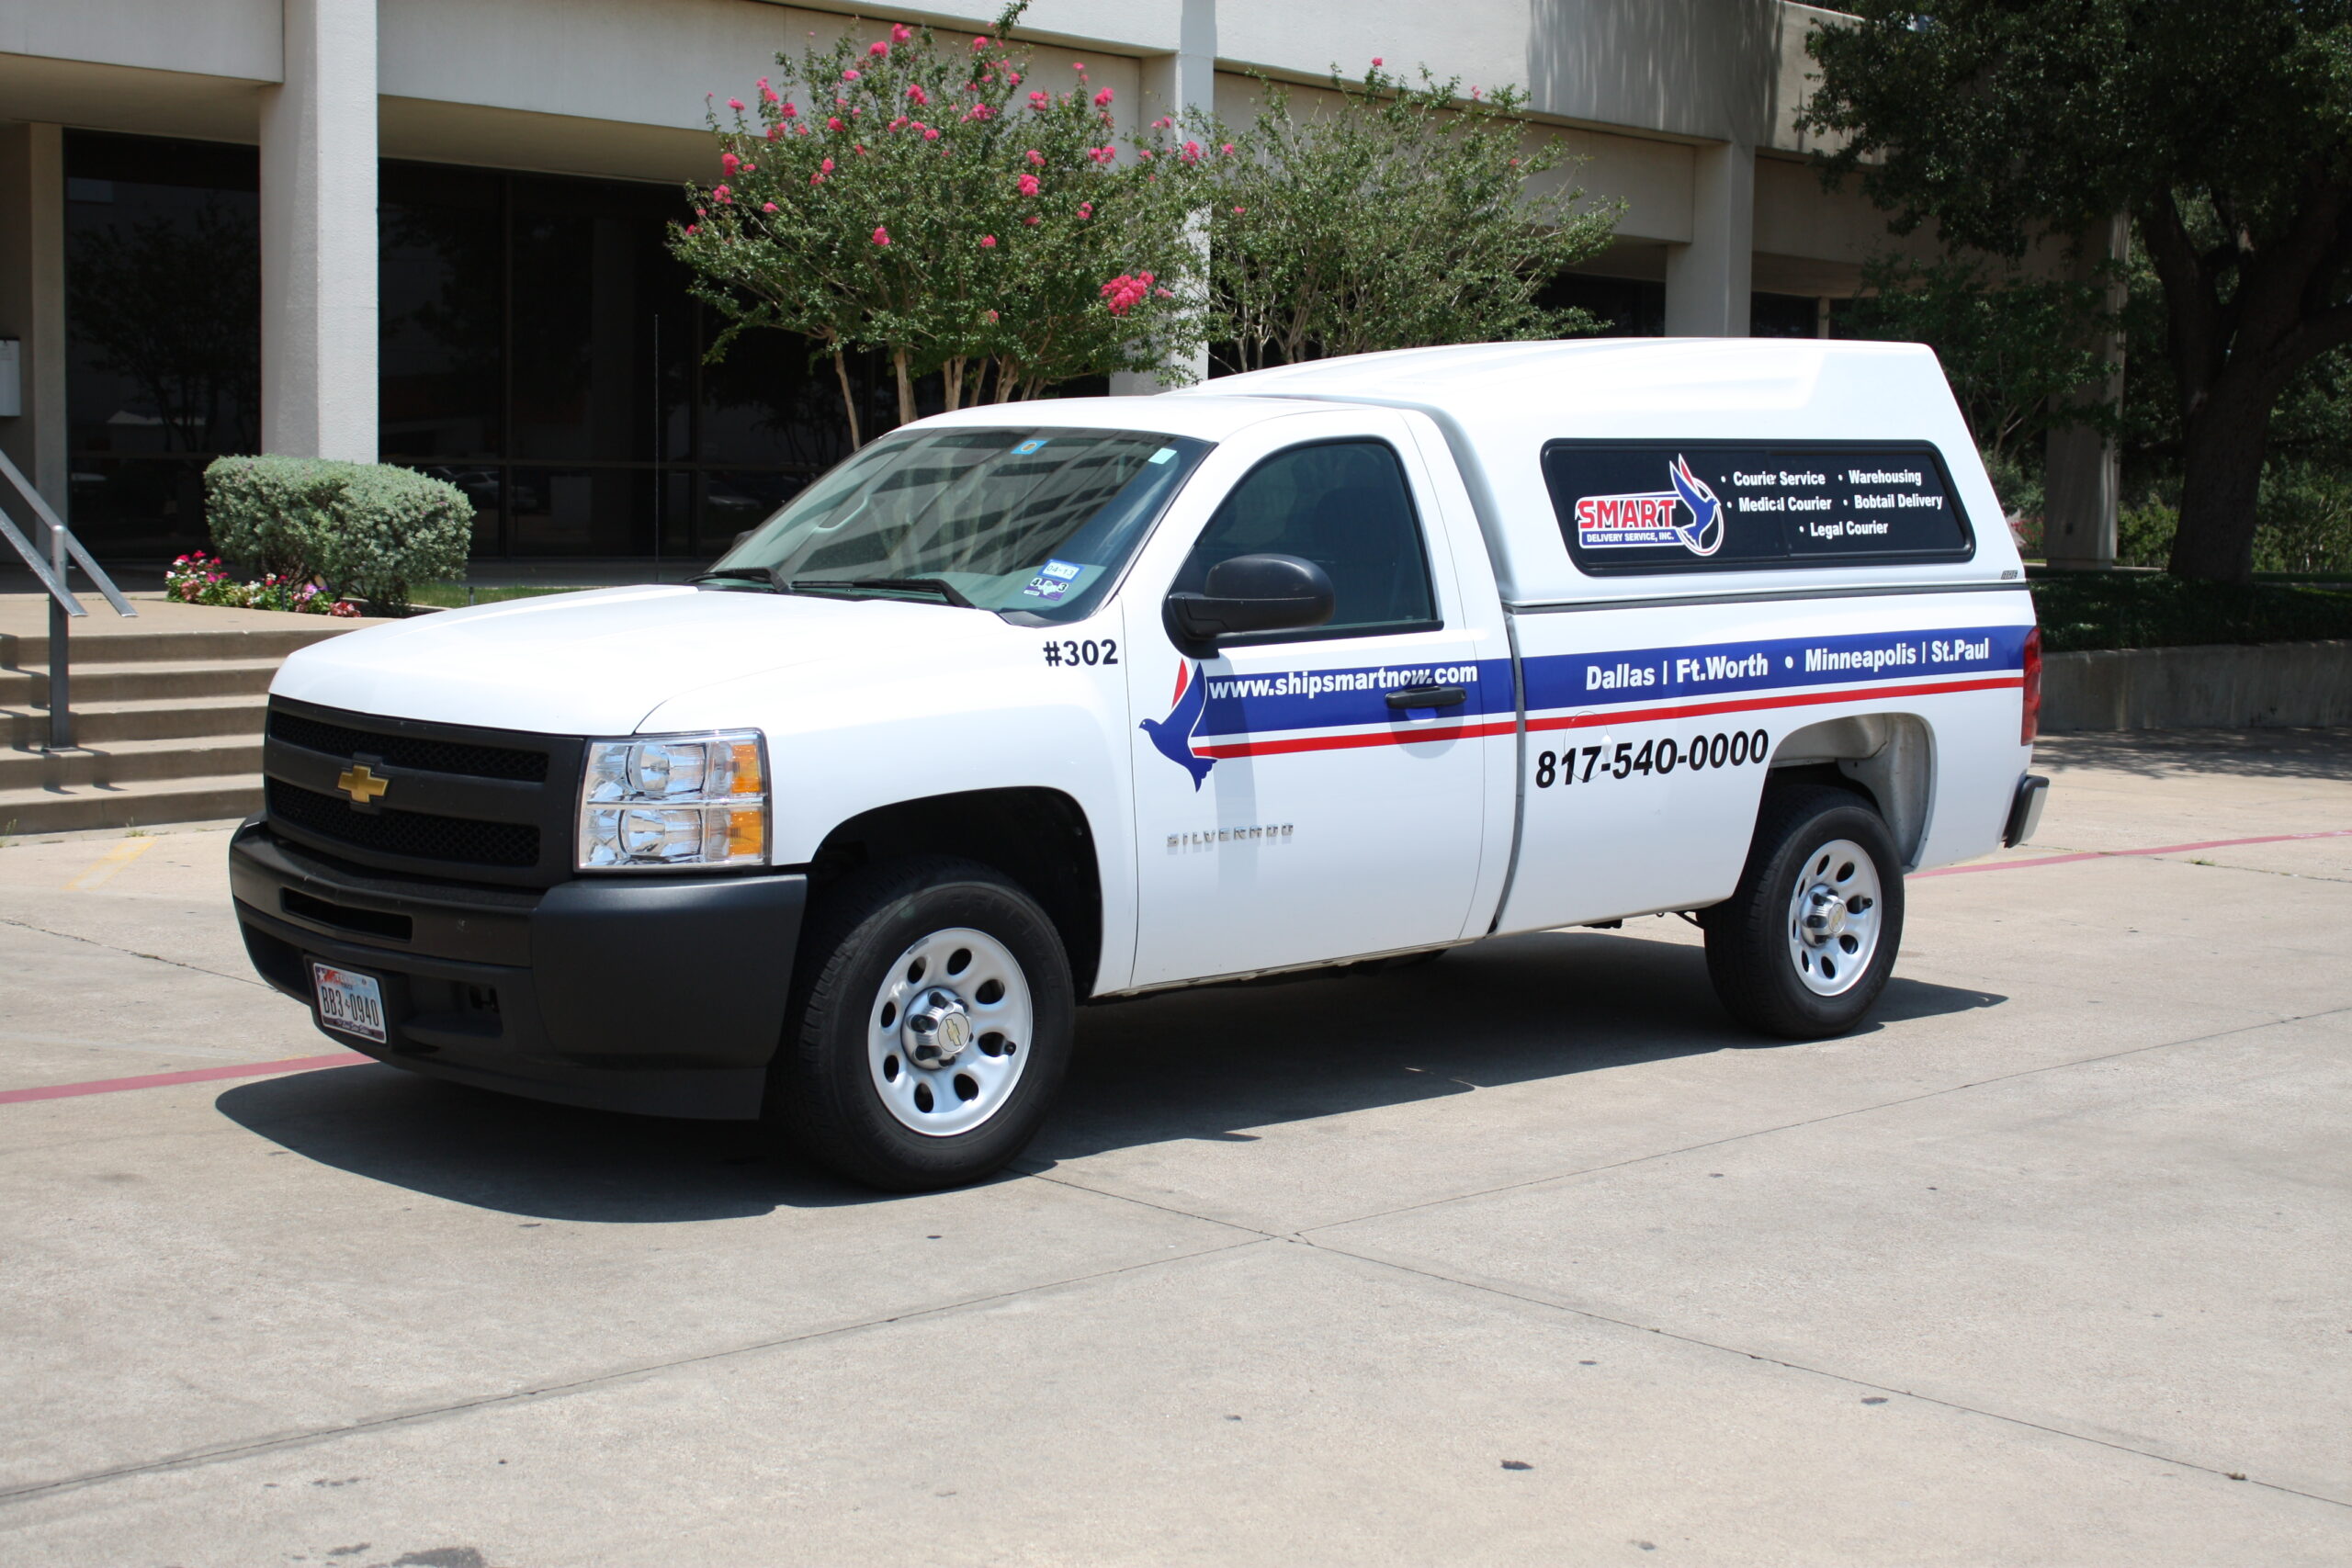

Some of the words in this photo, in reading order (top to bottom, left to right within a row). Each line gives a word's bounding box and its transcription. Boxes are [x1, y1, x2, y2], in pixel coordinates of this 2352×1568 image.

[1733, 471, 1777, 486] Courier
[1779, 471, 1826, 486] Service
[1848, 469, 1922, 486] Warehousing
[1738, 497, 1785, 512] Medical
[1788, 496, 1833, 511] Courier
[1854, 494, 1895, 509] Bobtail
[1897, 493, 1943, 510] Delivery
[1577, 499, 1676, 529] SMART
[1587, 533, 1623, 543] DELIVERY
[1624, 533, 1658, 543] SERVICE,
[1659, 532, 1675, 540] INC.
[1810, 521, 1844, 539] Legal
[1846, 520, 1889, 536] Courier
[1046, 565, 1075, 576] 04-13
[1043, 639, 1119, 667] #302
[1586, 664, 1656, 691] Dallas
[1676, 652, 1769, 682] Ft.Worth
[1804, 641, 1917, 673] Minneapolis
[1931, 637, 1989, 663] St.Paul
[1208, 665, 1478, 699] www.shipsmartnow.com
[1535, 728, 1769, 789] 817-540-0000
[1167, 823, 1294, 848] SILVERADO
[349, 993, 379, 1027] 0940
